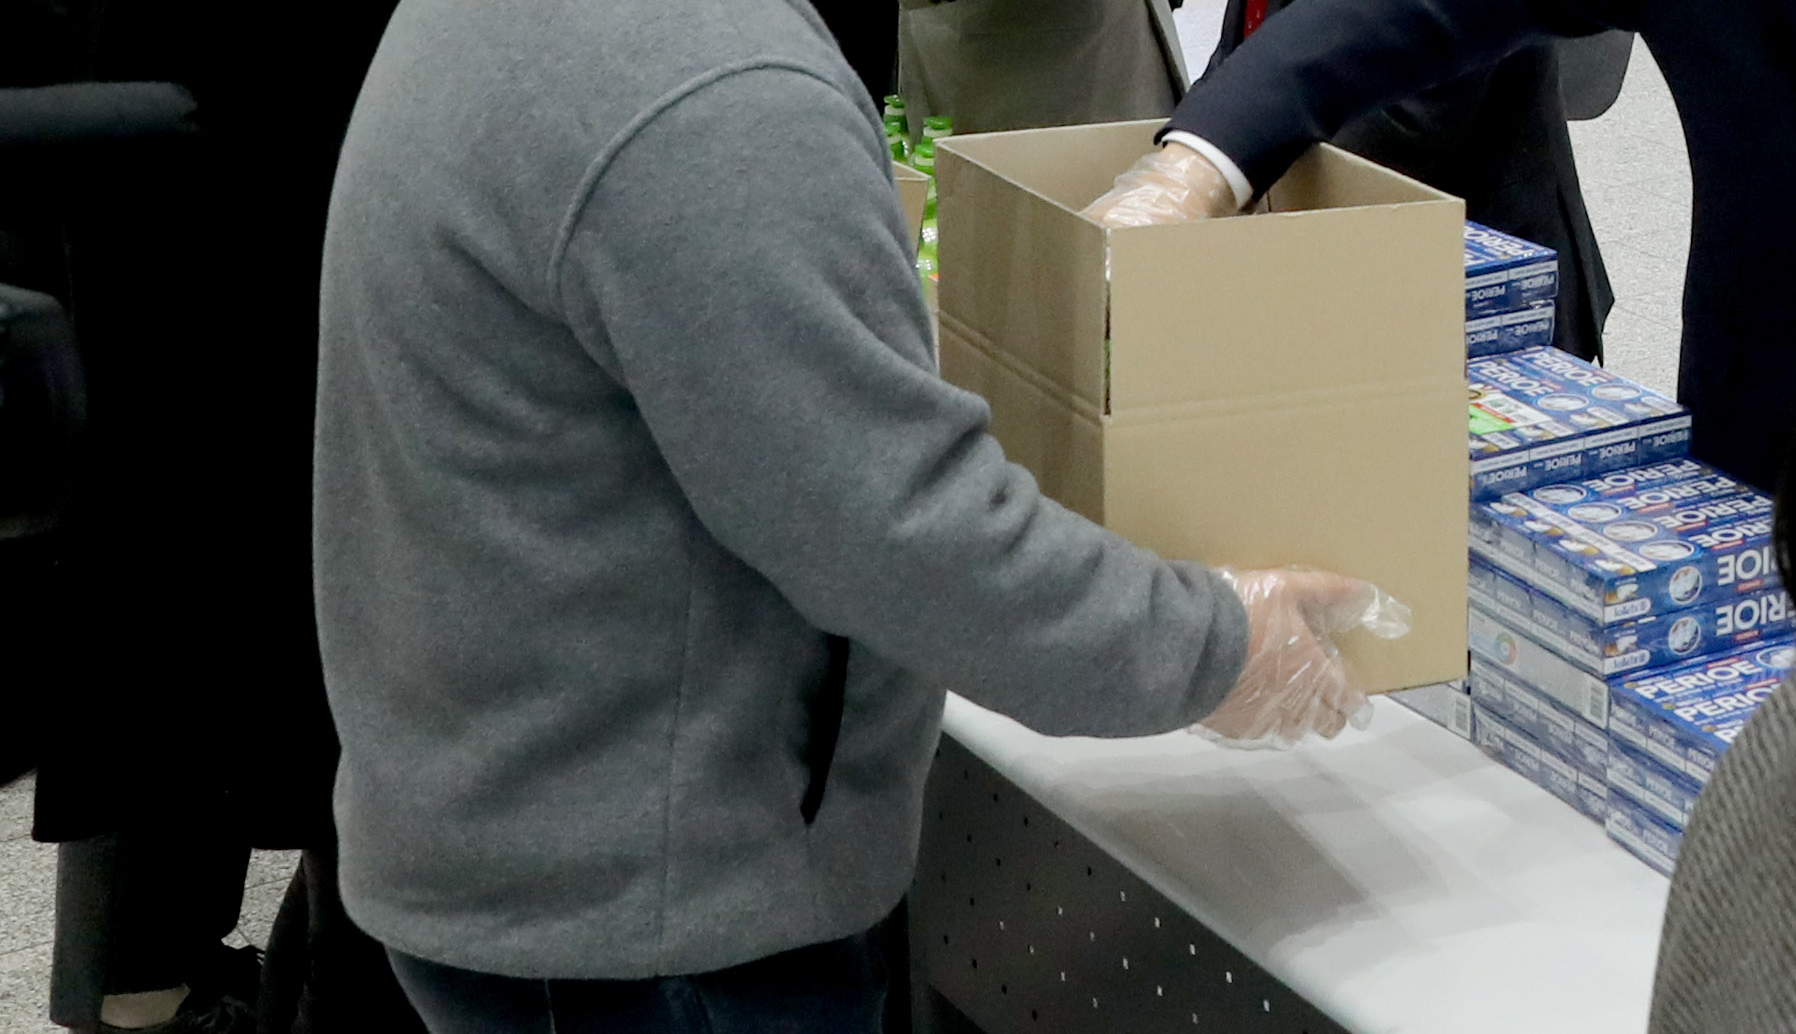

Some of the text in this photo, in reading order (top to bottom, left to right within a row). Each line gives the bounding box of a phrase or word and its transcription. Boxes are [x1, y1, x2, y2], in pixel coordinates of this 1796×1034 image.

[1467, 329, 1499, 345] PERIO
[1470, 360, 1554, 397] PERIOE
[1522, 350, 1608, 386] PERIOE
[1545, 453, 1583, 472] PERIOE
[1599, 442, 1636, 459] PERIOE
[1582, 459, 1702, 492] PERIOE
[1617, 475, 1737, 510] PERIOE
[1652, 494, 1774, 529] PERIOE
[1688, 523, 1773, 548] RIOE
[1634, 659, 1764, 699] PERIOE
[1673, 683, 1774, 722] PERIO
